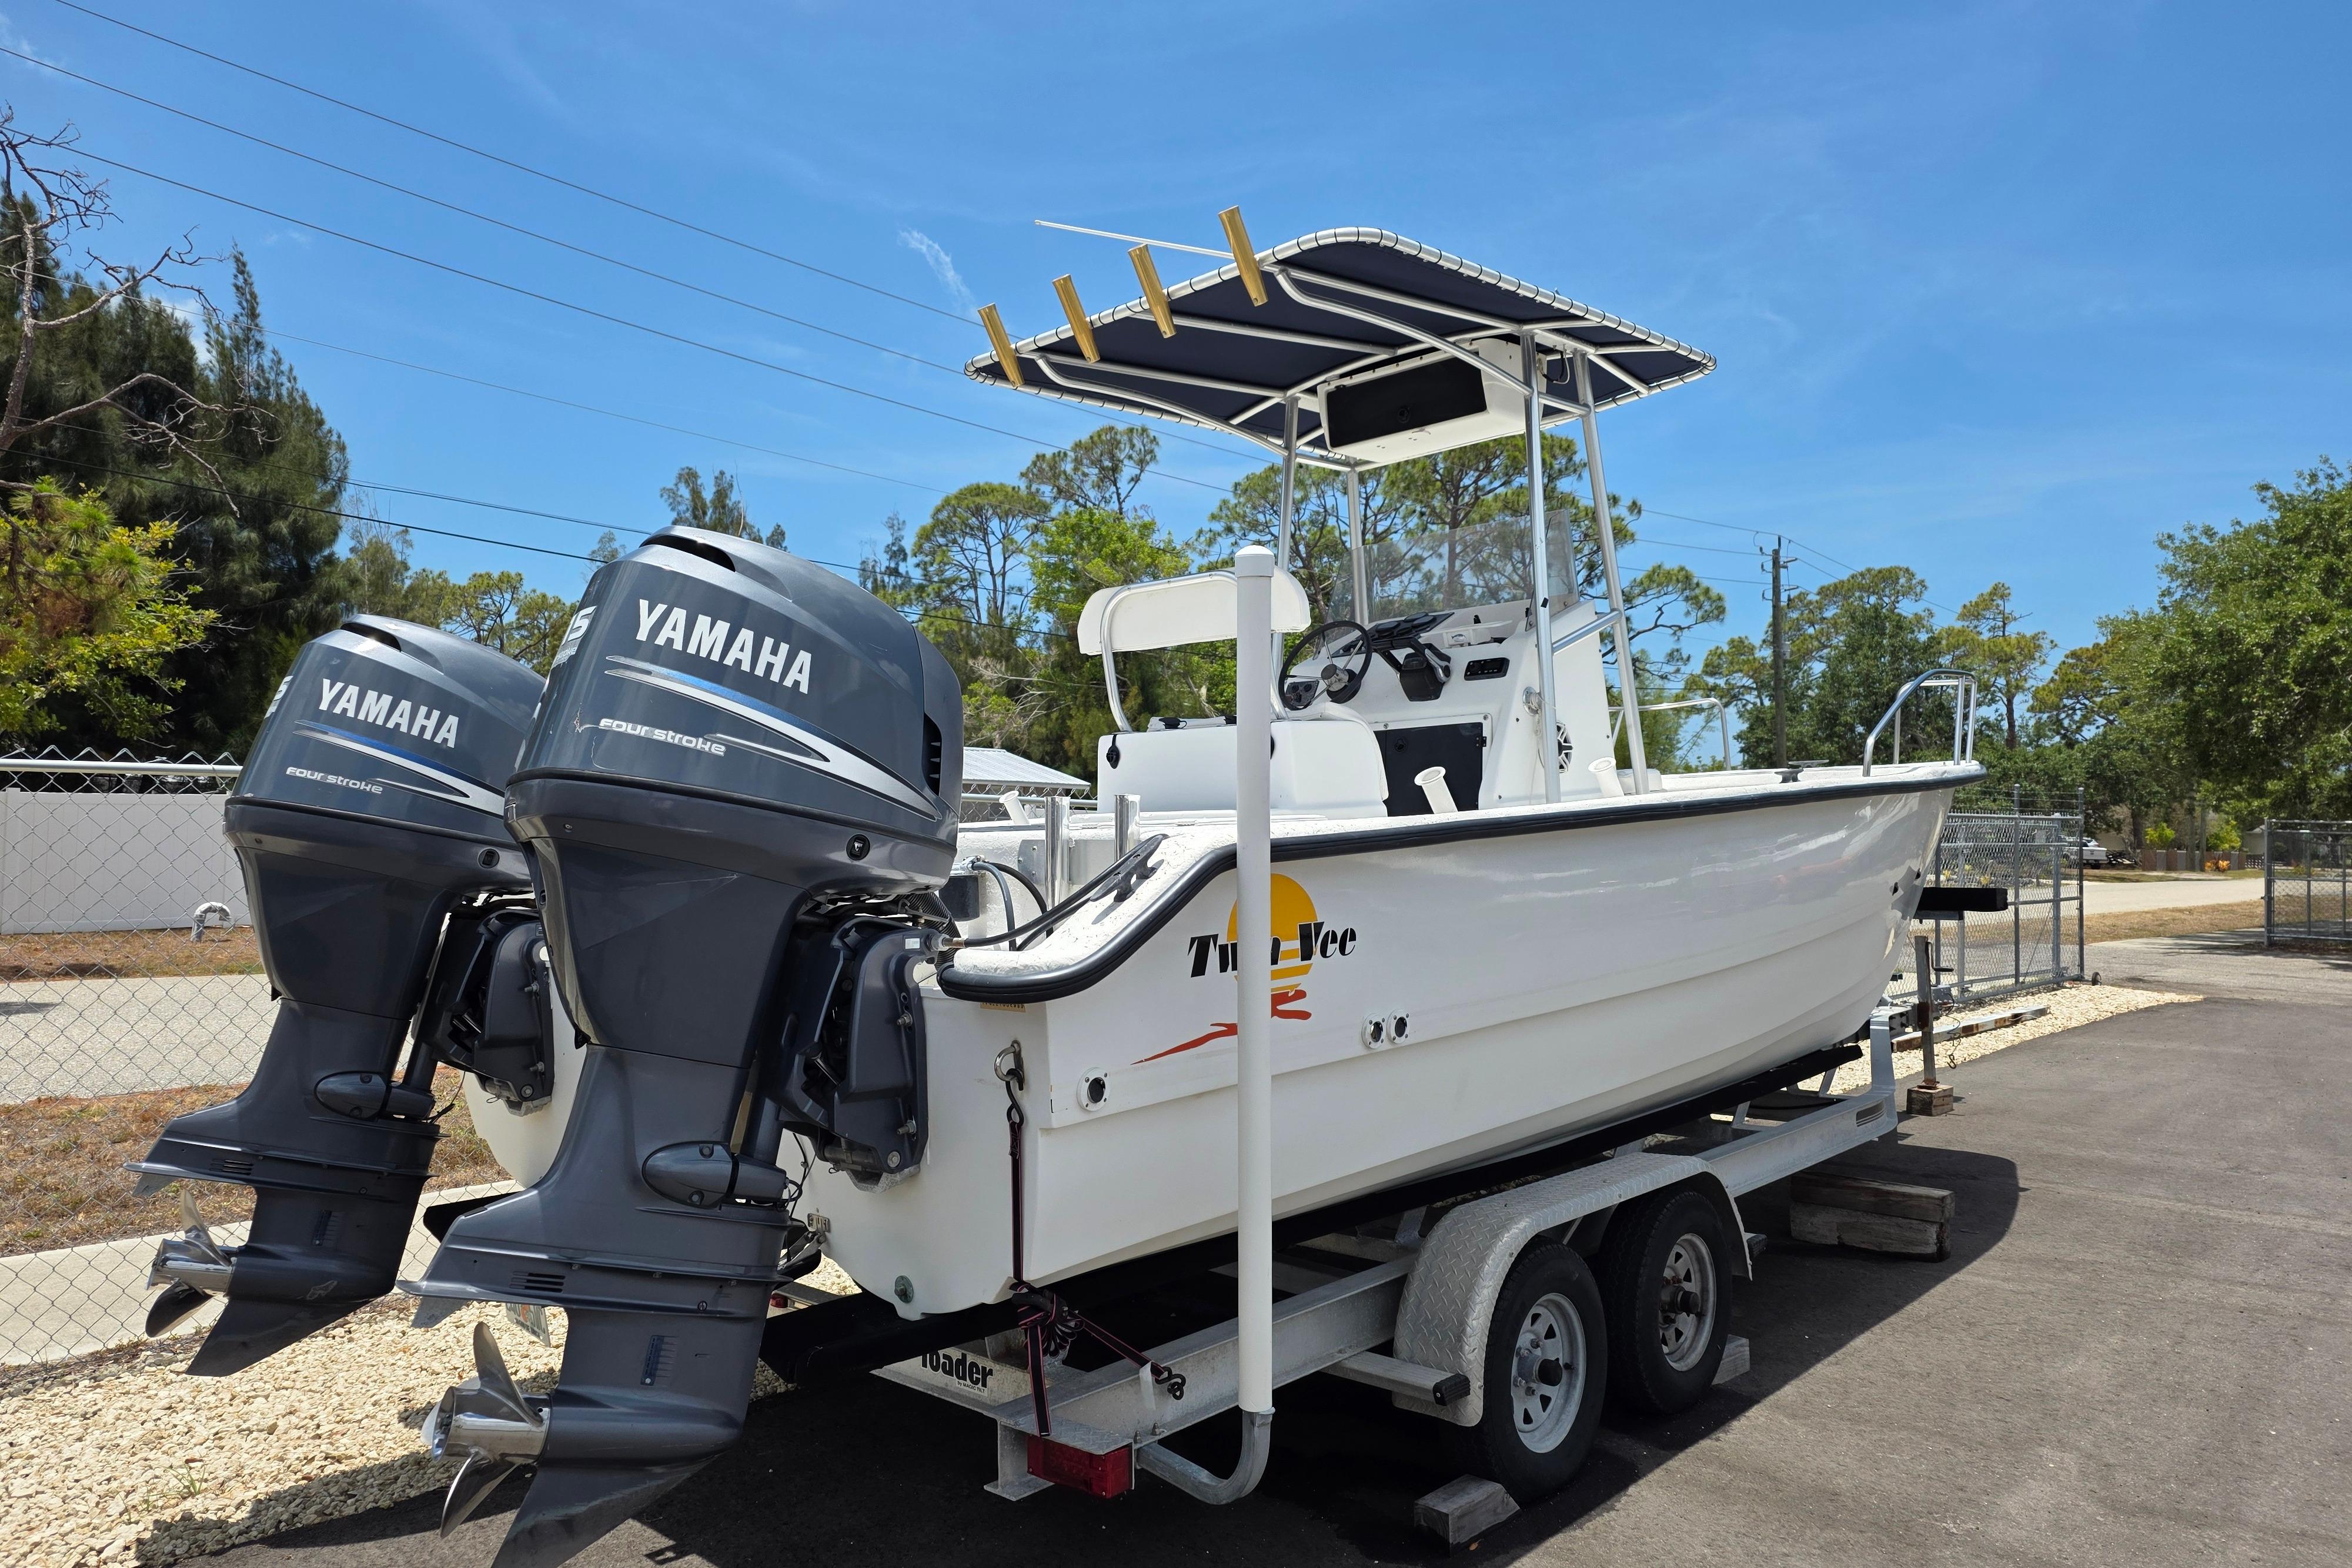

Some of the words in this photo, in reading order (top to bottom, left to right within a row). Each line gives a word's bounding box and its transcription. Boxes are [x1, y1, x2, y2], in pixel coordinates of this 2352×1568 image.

[636, 599, 811, 694] YAMAHA
[319, 678, 459, 748] YAMAHA
[1187, 933, 1281, 978] Twn
[1298, 921, 1357, 962] Vee
[963, 1382, 976, 1390] MAGIC
